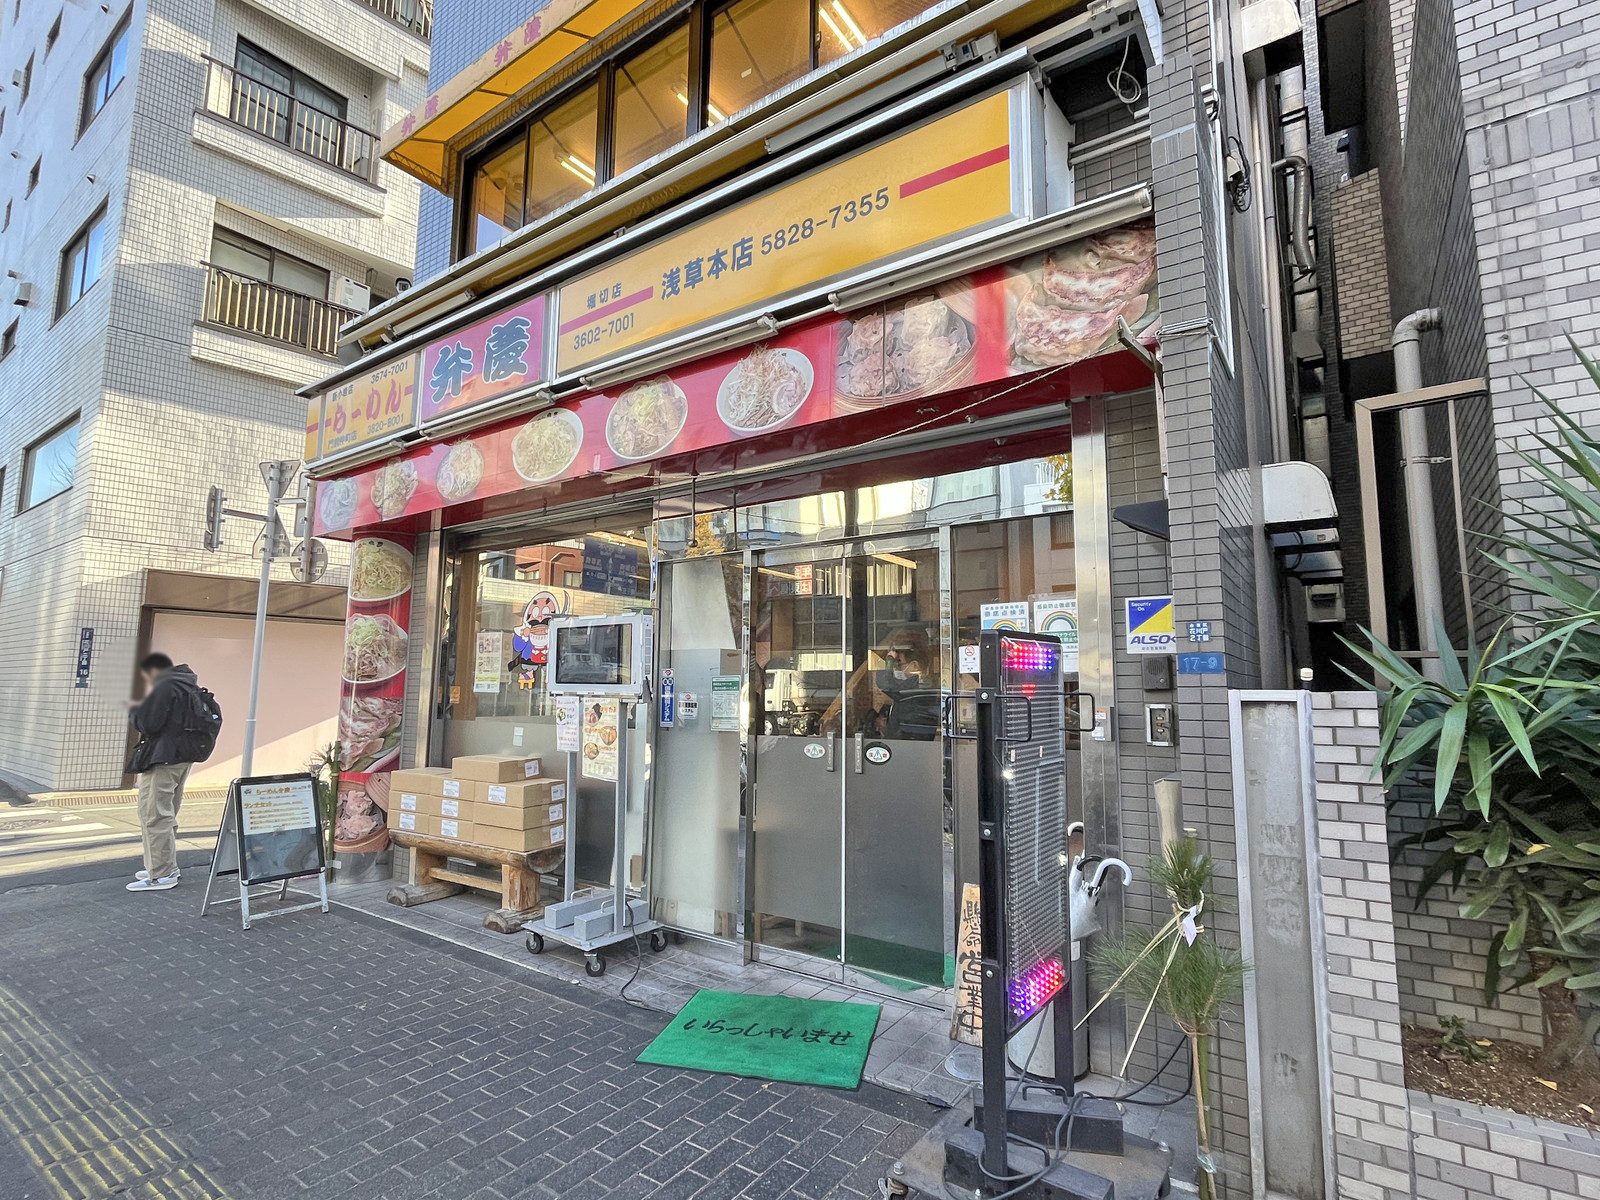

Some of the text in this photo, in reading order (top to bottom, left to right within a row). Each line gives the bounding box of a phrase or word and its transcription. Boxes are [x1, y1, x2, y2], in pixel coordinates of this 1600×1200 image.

[493, 15, 542, 68] 弁慶
[400, 94, 439, 138] 弁慶
[660, 187, 890, 300] 浅草本店 5828-7355
[586, 282, 623, 309] 堀切店
[573, 312, 635, 351] 3602-7001
[370, 360, 409, 385] 3674-7001
[429, 316, 532, 404] 弁慶
[367, 413, 404, 435] 3820-8001
[1183, 656, 1218, 673] 17-9
[683, 1017, 854, 1047] いらっしゃいませ
